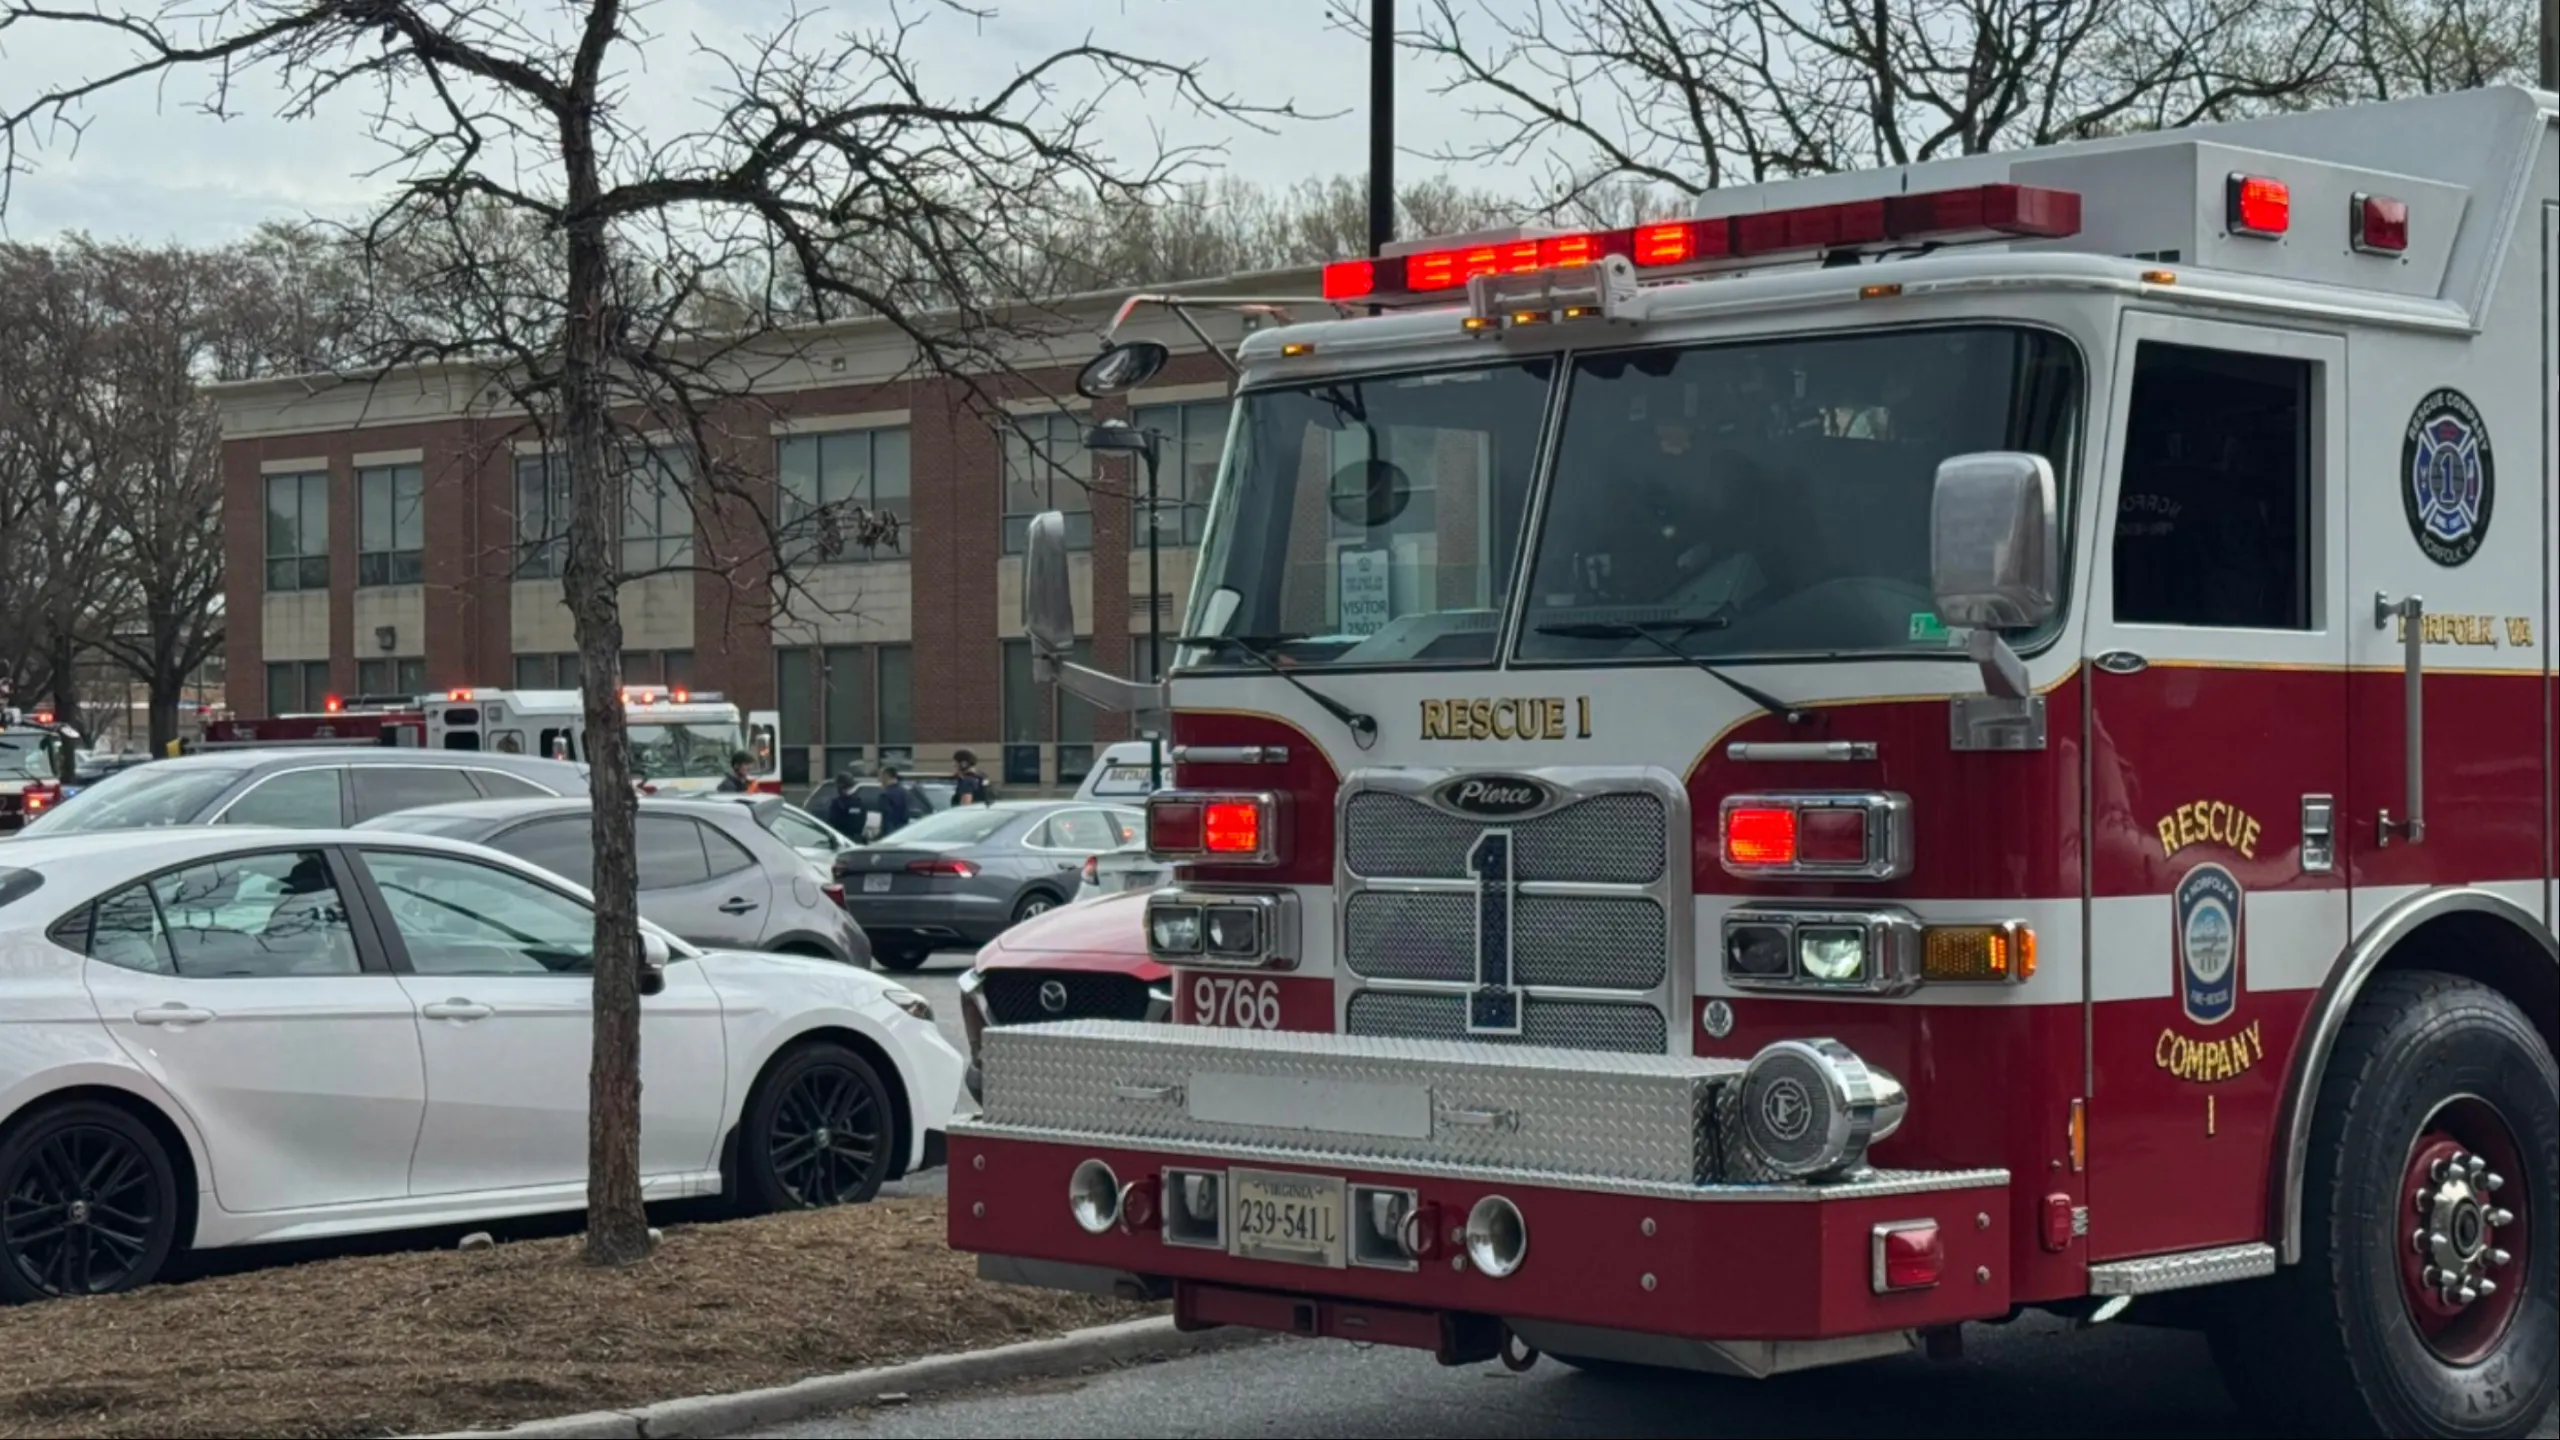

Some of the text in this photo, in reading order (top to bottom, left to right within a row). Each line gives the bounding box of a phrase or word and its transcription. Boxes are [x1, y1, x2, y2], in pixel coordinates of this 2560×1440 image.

[2408, 392, 2488, 450] RESCUE COMPANY
[1343, 600, 1387, 616] VISITOR
[2505, 616, 2534, 647] VA
[1420, 695, 1592, 740] RESCUE 1
[1456, 780, 1532, 807] Pierce
[2157, 801, 2261, 859] RESCUE
[1467, 828, 1522, 1034] 1
[1194, 977, 1280, 1029] 9766
[2155, 1020, 2264, 1082] COMPANY
[1262, 1181, 1314, 1199] VIRGINIA
